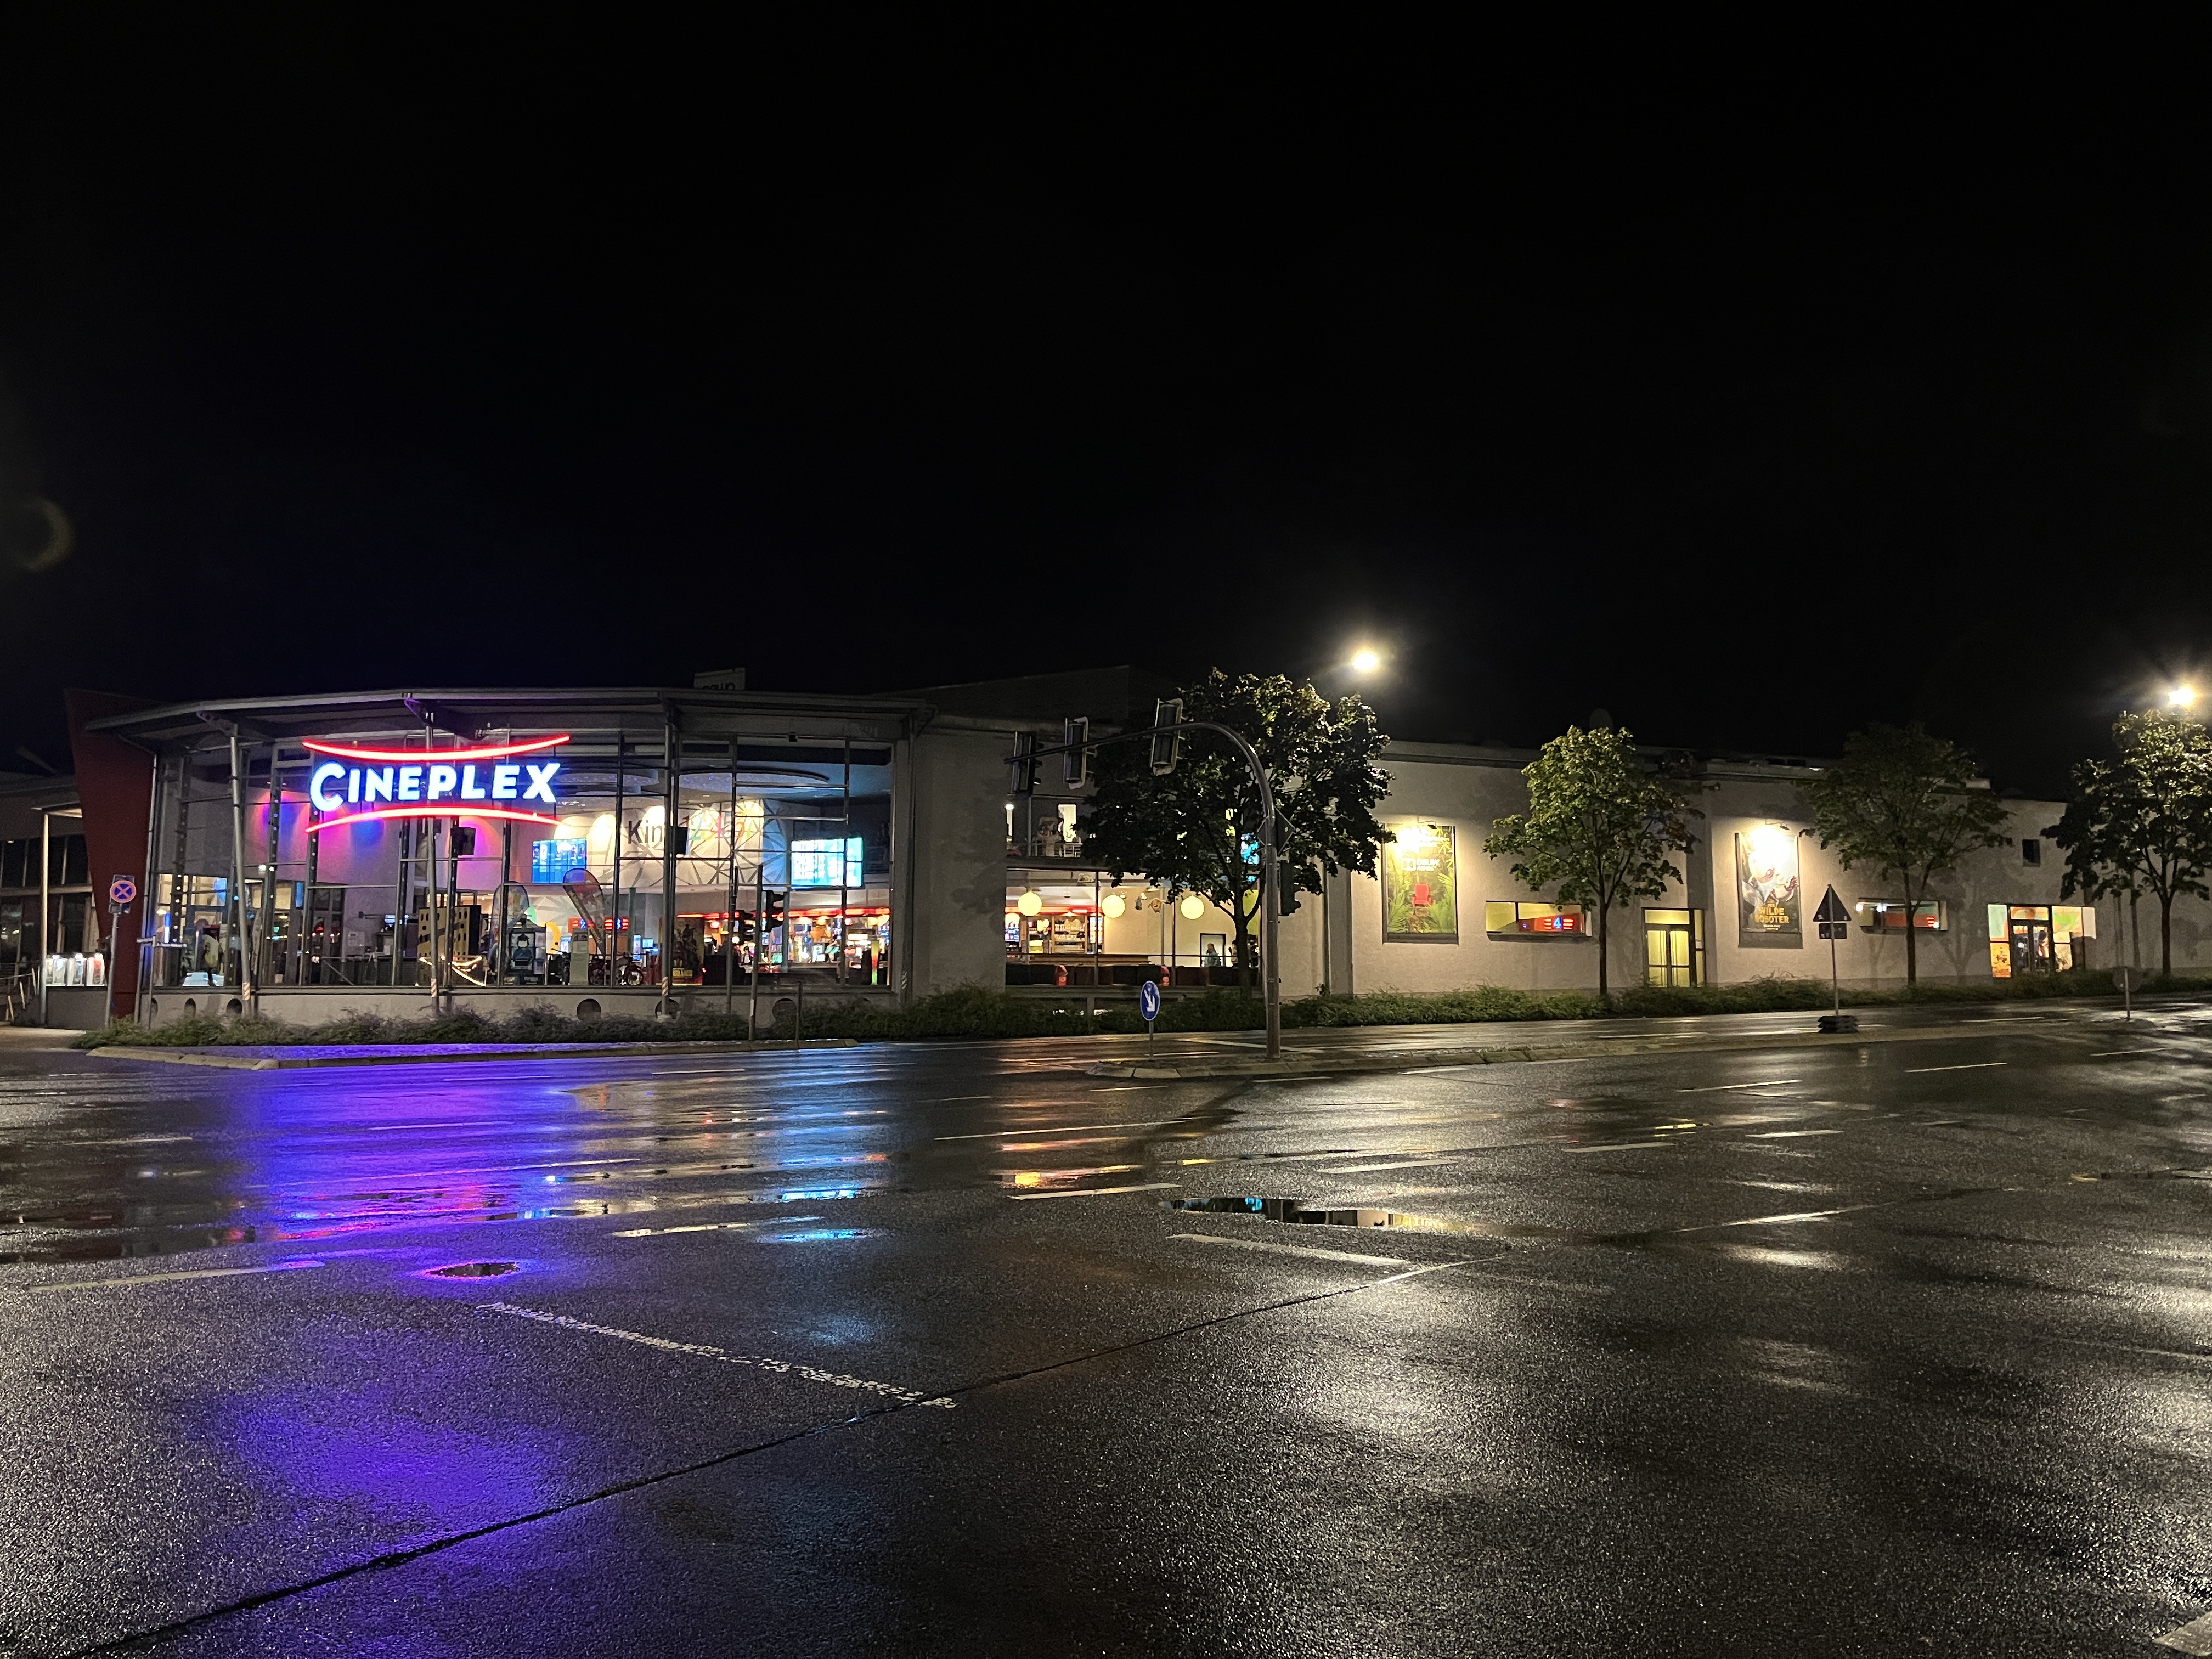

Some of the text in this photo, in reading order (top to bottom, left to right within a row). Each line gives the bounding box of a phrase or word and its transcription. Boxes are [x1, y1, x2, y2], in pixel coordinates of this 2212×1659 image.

[310, 761, 561, 811] CINEPLEX
[628, 820, 663, 844] Kin
[1759, 907, 1784, 915] WILDE
[580, 919, 586, 929] 2
[1554, 917, 1562, 928] 4
[1755, 915, 1789, 923] ROBOTER
